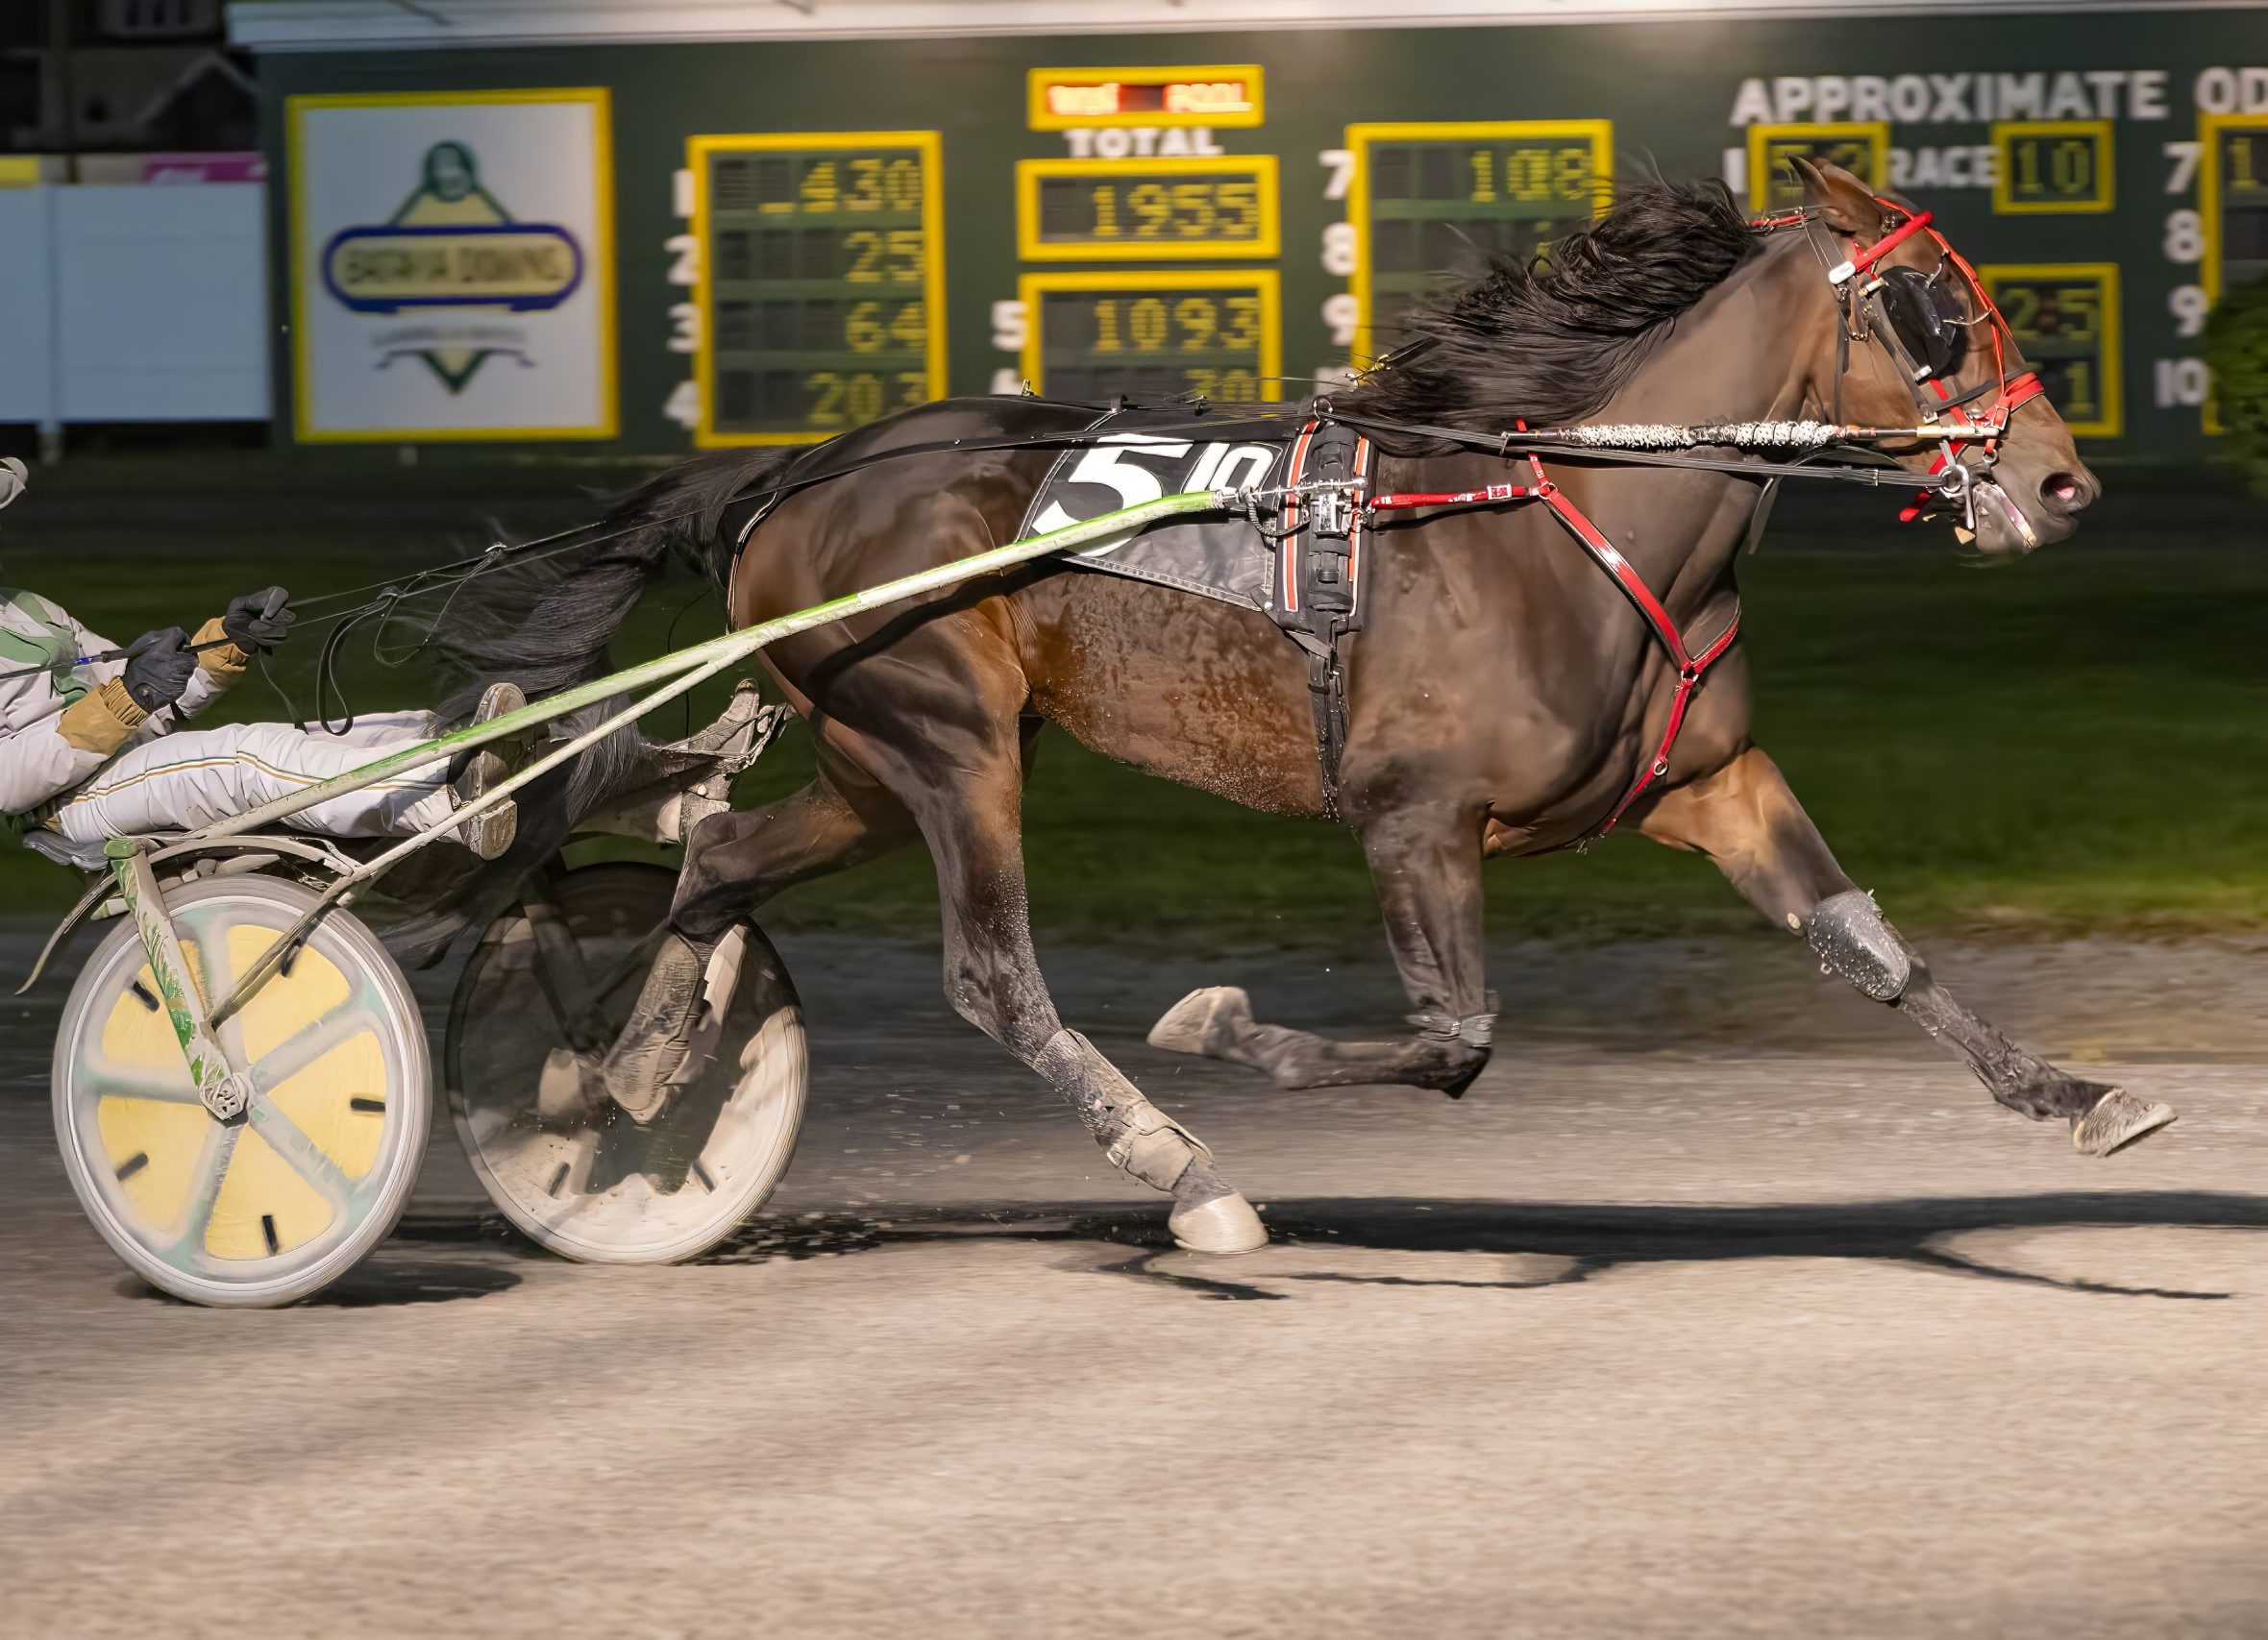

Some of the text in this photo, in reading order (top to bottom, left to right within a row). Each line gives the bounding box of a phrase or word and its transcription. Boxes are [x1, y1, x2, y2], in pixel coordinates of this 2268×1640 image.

[1730, 70, 2170, 126] APPROXIMATE
[1063, 128, 1224, 158] TOTAL
[1889, 145, 2002, 189] RACE
[2016, 140, 2091, 194] 10
[2164, 141, 2205, 194] 7
[673, 168, 695, 218] 1
[1318, 150, 1356, 200] 7
[1469, 148, 1593, 202] 108
[1093, 184, 1260, 236] 1955
[2165, 208, 2206, 264] 8
[663, 234, 699, 285] 2
[843, 231, 924, 283] 25
[1320, 222, 1357, 276] 8
[666, 303, 703, 354] 3
[846, 301, 926, 355] 64
[990, 300, 1028, 352] 5
[1094, 298, 1261, 354] 1093
[1320, 294, 1359, 346] 9
[2169, 285, 2209, 337] 9
[663, 380, 703, 430] 4
[2155, 356, 2209, 408] 10
[1032, 433, 1195, 557] 5
